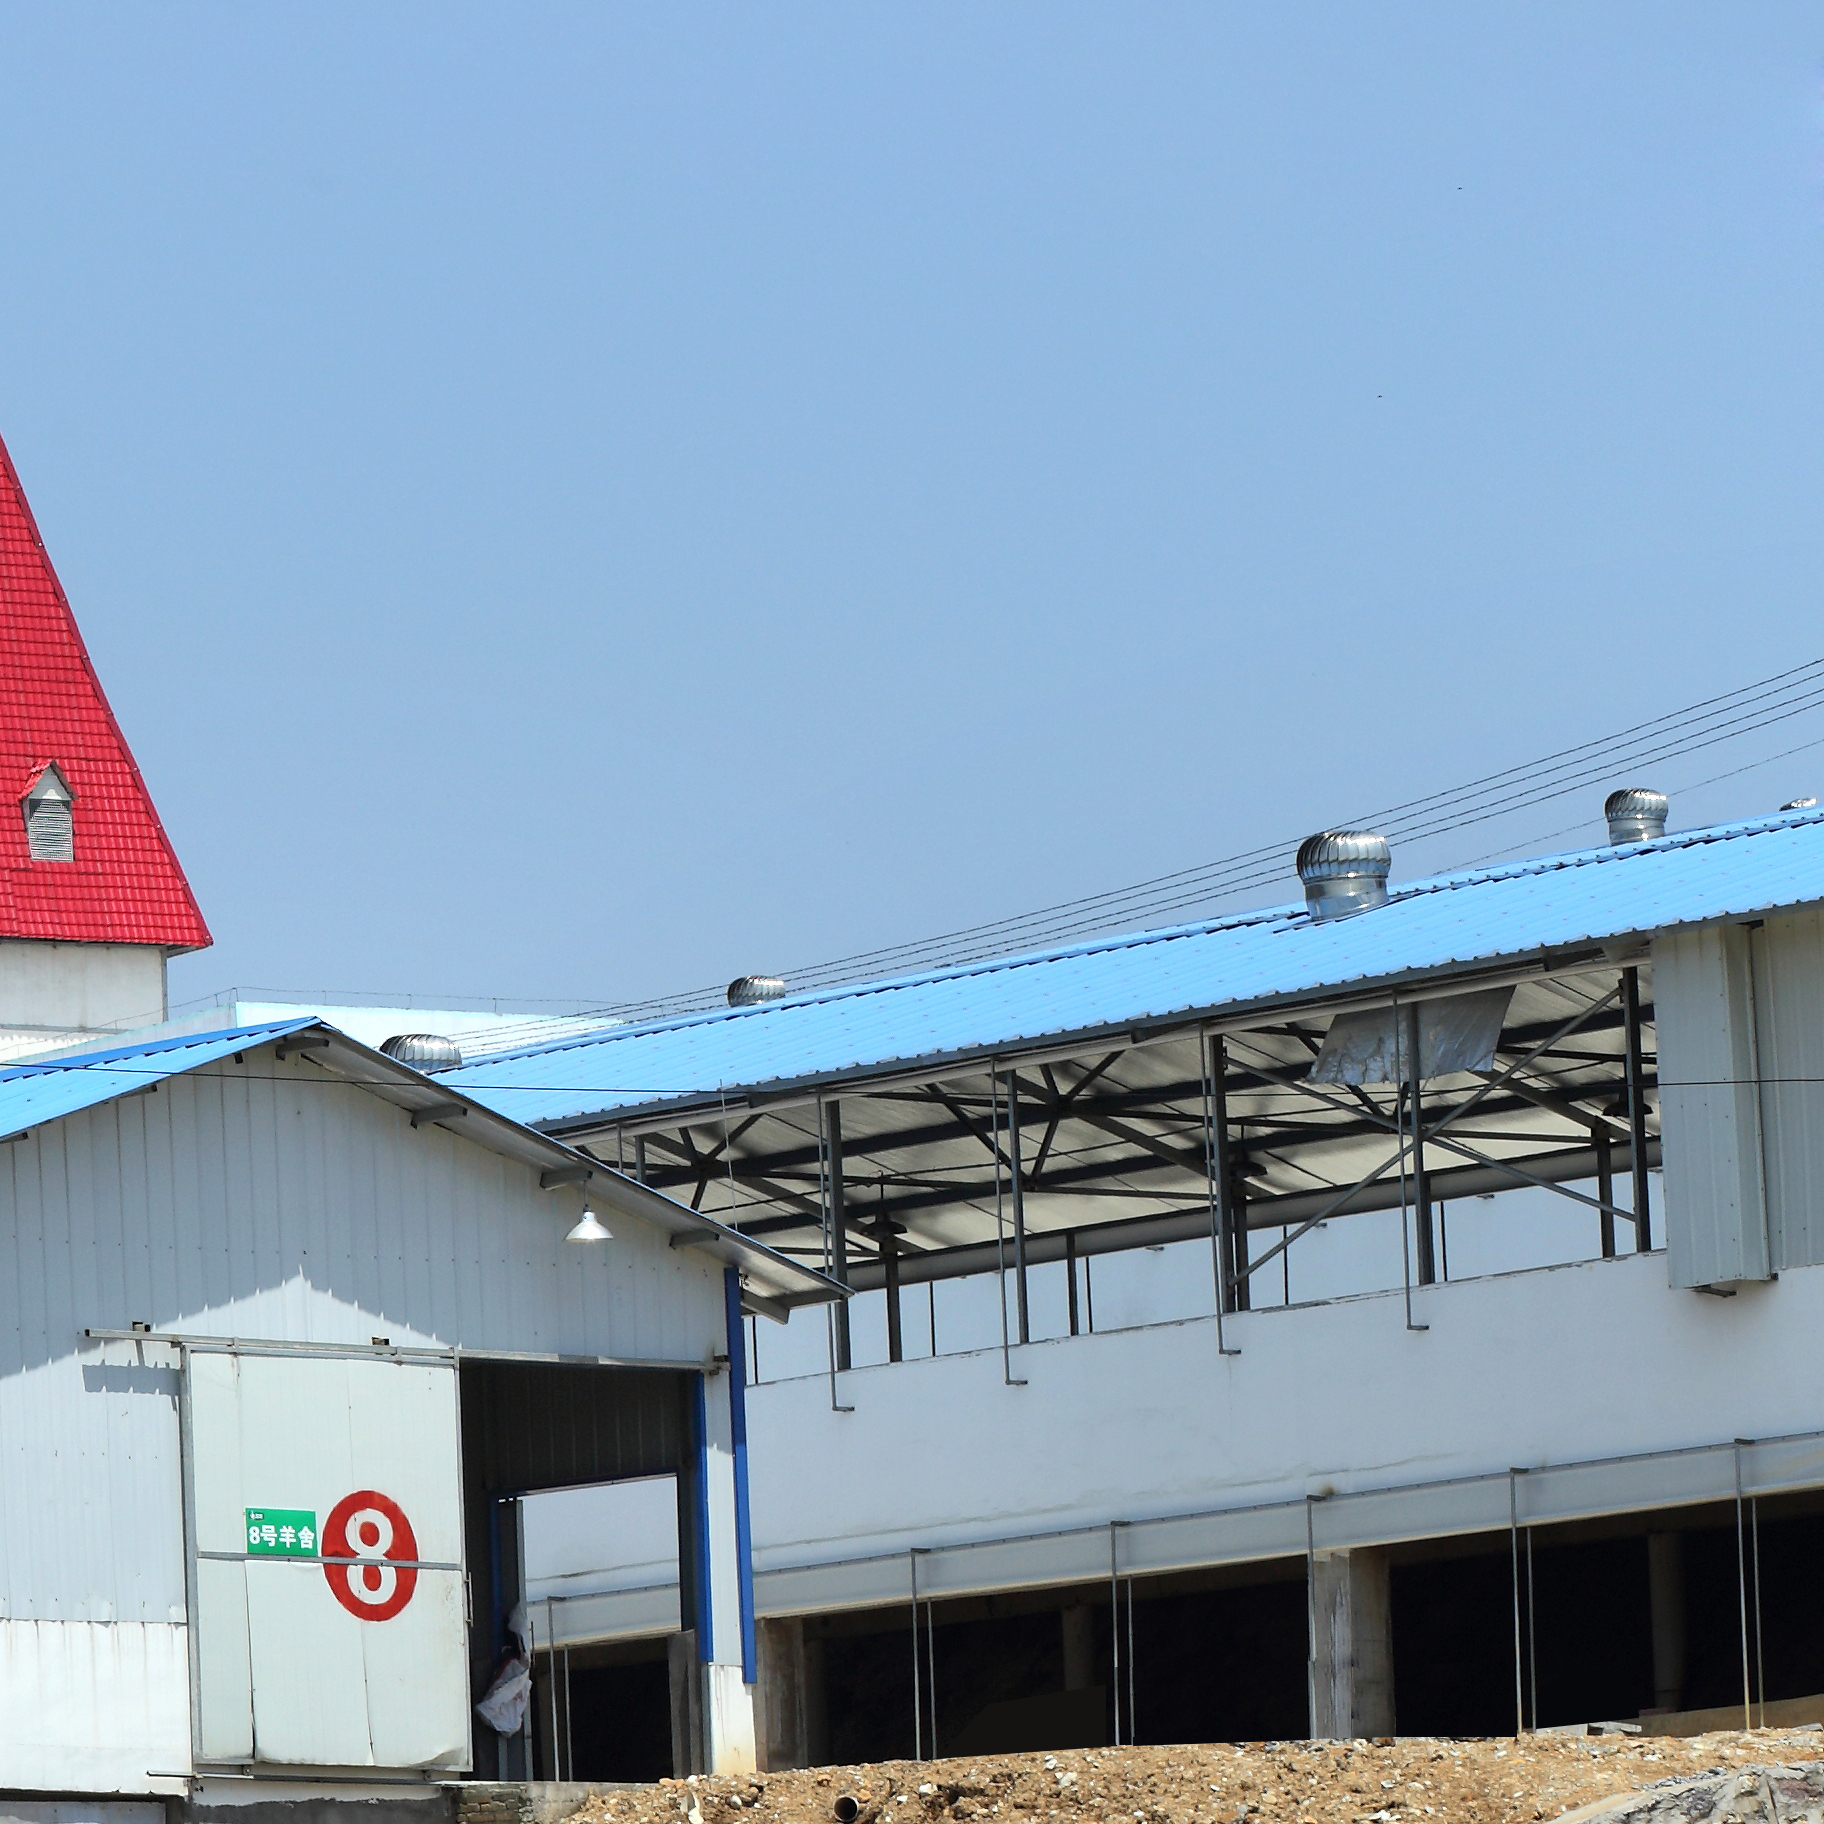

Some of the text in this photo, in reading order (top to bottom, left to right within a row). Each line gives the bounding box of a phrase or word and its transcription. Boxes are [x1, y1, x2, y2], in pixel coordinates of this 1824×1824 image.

[248, 1524, 315, 1549] 8号羊舍
[345, 1507, 398, 1606] 8
